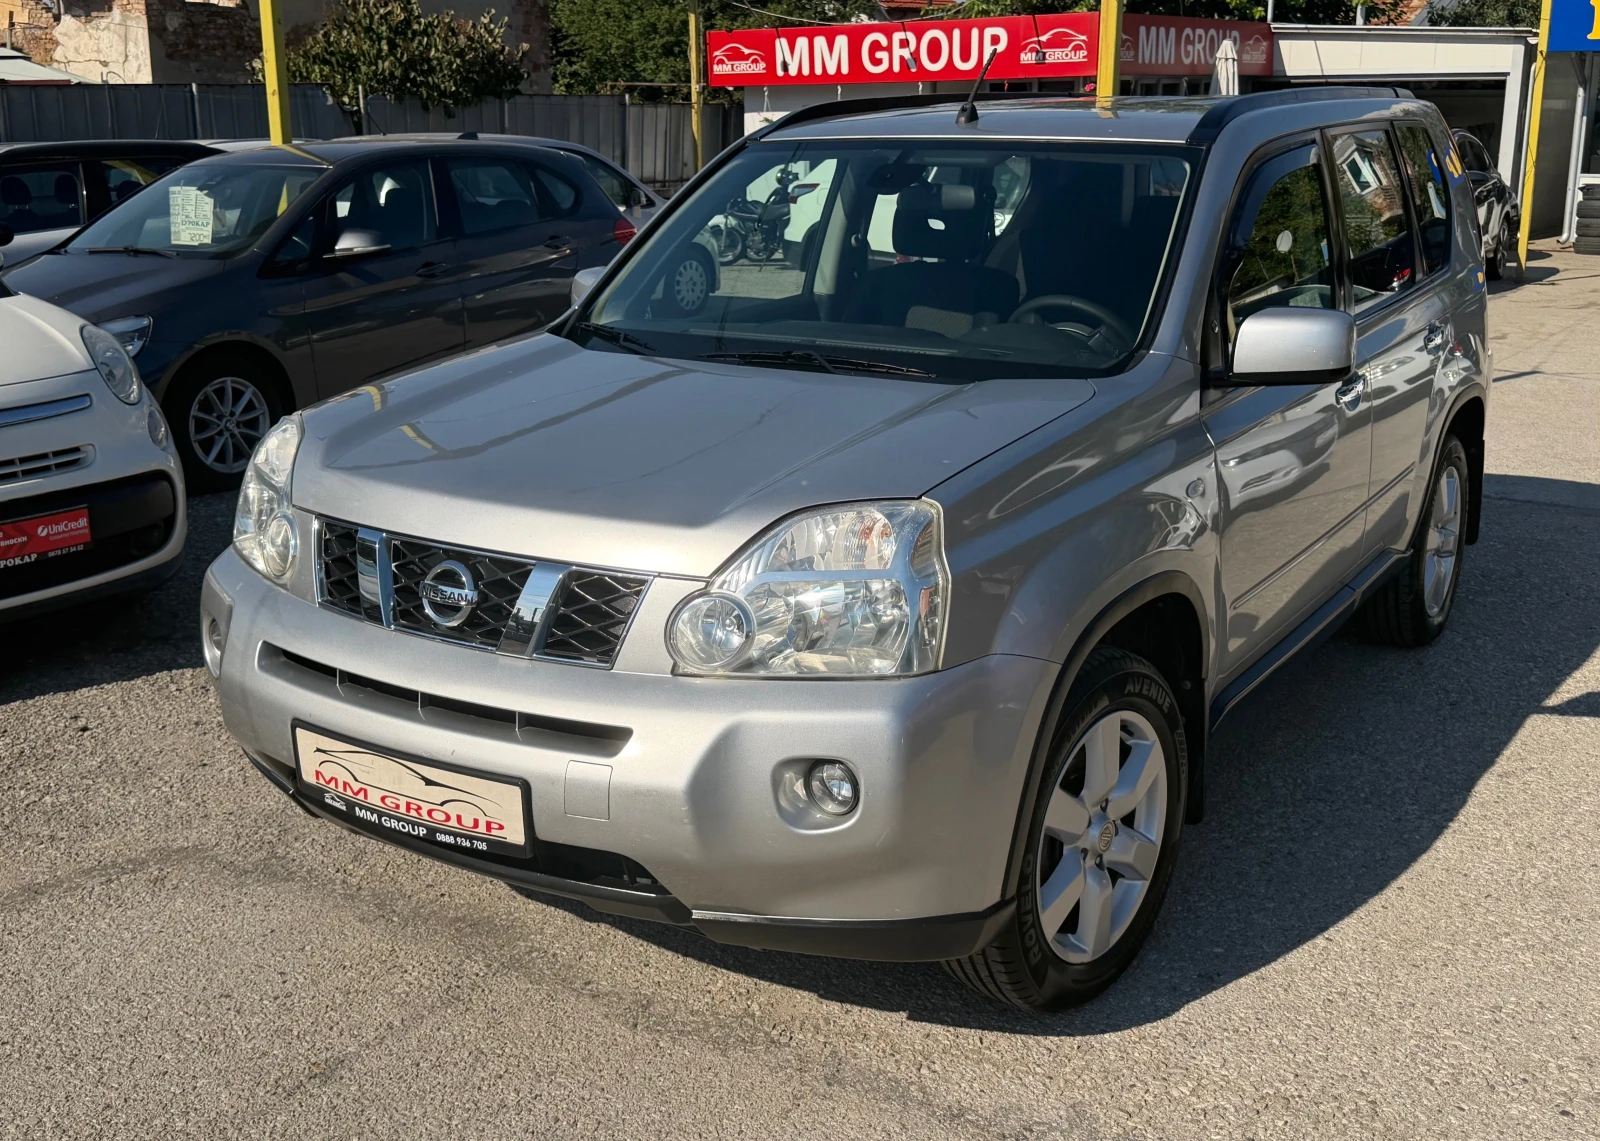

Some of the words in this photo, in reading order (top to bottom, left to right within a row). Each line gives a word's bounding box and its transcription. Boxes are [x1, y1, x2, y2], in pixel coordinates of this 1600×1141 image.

[775, 34, 849, 77] MM
[861, 27, 1008, 74] GROUP
[1020, 51, 1045, 62] MM
[1046, 50, 1088, 60] GROUP
[1138, 25, 1176, 65] MM
[713, 64, 732, 72] MM
[733, 62, 766, 71] GROUP
[48, 517, 88, 534] UniCredit
[421, 586, 468, 603] NISSAN
[1124, 676, 1171, 714] AVENUE
[315, 769, 369, 801] MM
[380, 795, 505, 834] GROUP
[354, 806, 379, 824] MM
[381, 816, 427, 838] GROUP
[436, 832, 455, 844] 0888
[456, 838, 471, 848] 936
[472, 840, 488, 850] 705
[1021, 853, 1043, 968] ROVELO
